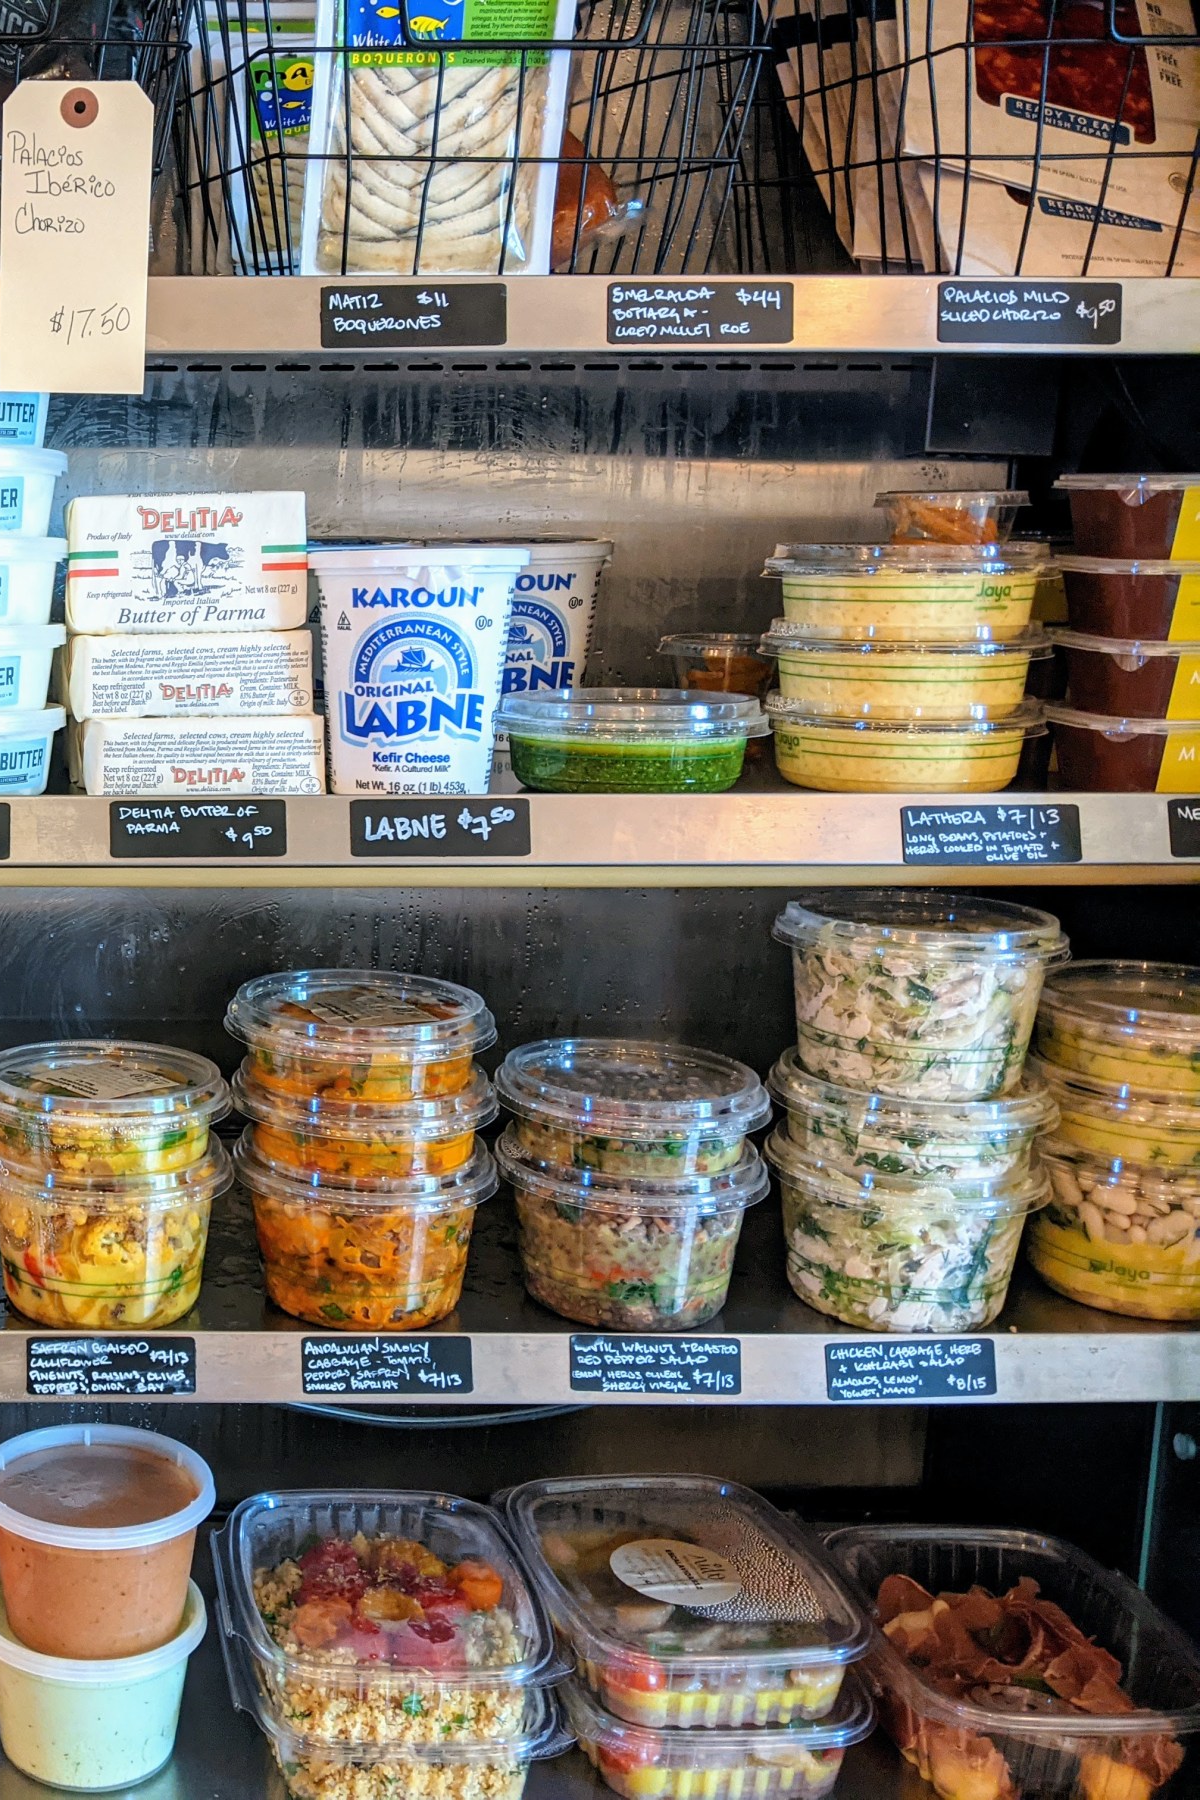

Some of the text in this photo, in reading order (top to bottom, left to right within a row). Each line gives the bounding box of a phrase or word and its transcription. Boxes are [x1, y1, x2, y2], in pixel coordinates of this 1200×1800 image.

[352, 52, 455, 65] BOQUERONS
[329, 292, 383, 310] MATIZ
[735, 288, 781, 310] $44
[1024, 288, 1070, 303] MILD
[49, 302, 131, 346] $17.50
[941, 308, 1061, 323] SLICED CHORIZO
[333, 315, 441, 334] BOQUERONES
[720, 322, 750, 335] ROE
[136, 505, 243, 532] DELITIA
[351, 587, 480, 608] KAROUN
[977, 578, 1012, 602] Jaya
[162, 598, 194, 606] Imported
[117, 604, 266, 626] Butter of Parma
[548, 618, 563, 647] STYLE
[359, 623, 452, 675] MEDITERRANEAN
[451, 642, 470, 676] STYLE
[158, 683, 234, 702] DELITIA
[353, 681, 434, 698] ORIGINAL
[344, 692, 485, 738] LABNE
[0, 748, 43, 771] BUTTER
[373, 751, 451, 762] Kefir Cheese
[170, 766, 245, 785] DELITIA
[119, 805, 259, 819] DELITIA BUTTER OF
[907, 806, 1062, 831] LATHERA $7/13
[126, 821, 181, 834] PARMA
[364, 813, 447, 841] LABNE
[906, 834, 936, 848] LONG
[986, 851, 1049, 863] OLIVE OIL
[91, 1342, 150, 1355] BRAISED
[381, 1341, 429, 1359] SMOKY
[622, 1342, 676, 1355] WALNUT
[950, 1344, 983, 1357] HERB
[307, 1356, 372, 1370] CABBAGE
[577, 1354, 709, 1366] RED PEPPER SALAD
[918, 1356, 965, 1367] SALAD
[417, 1368, 462, 1389] $7/13
[692, 1368, 735, 1391] $7/13
[946, 1374, 987, 1391] $8/15
[135, 1382, 165, 1393] BAY
[883, 1386, 916, 1395] MAYO
